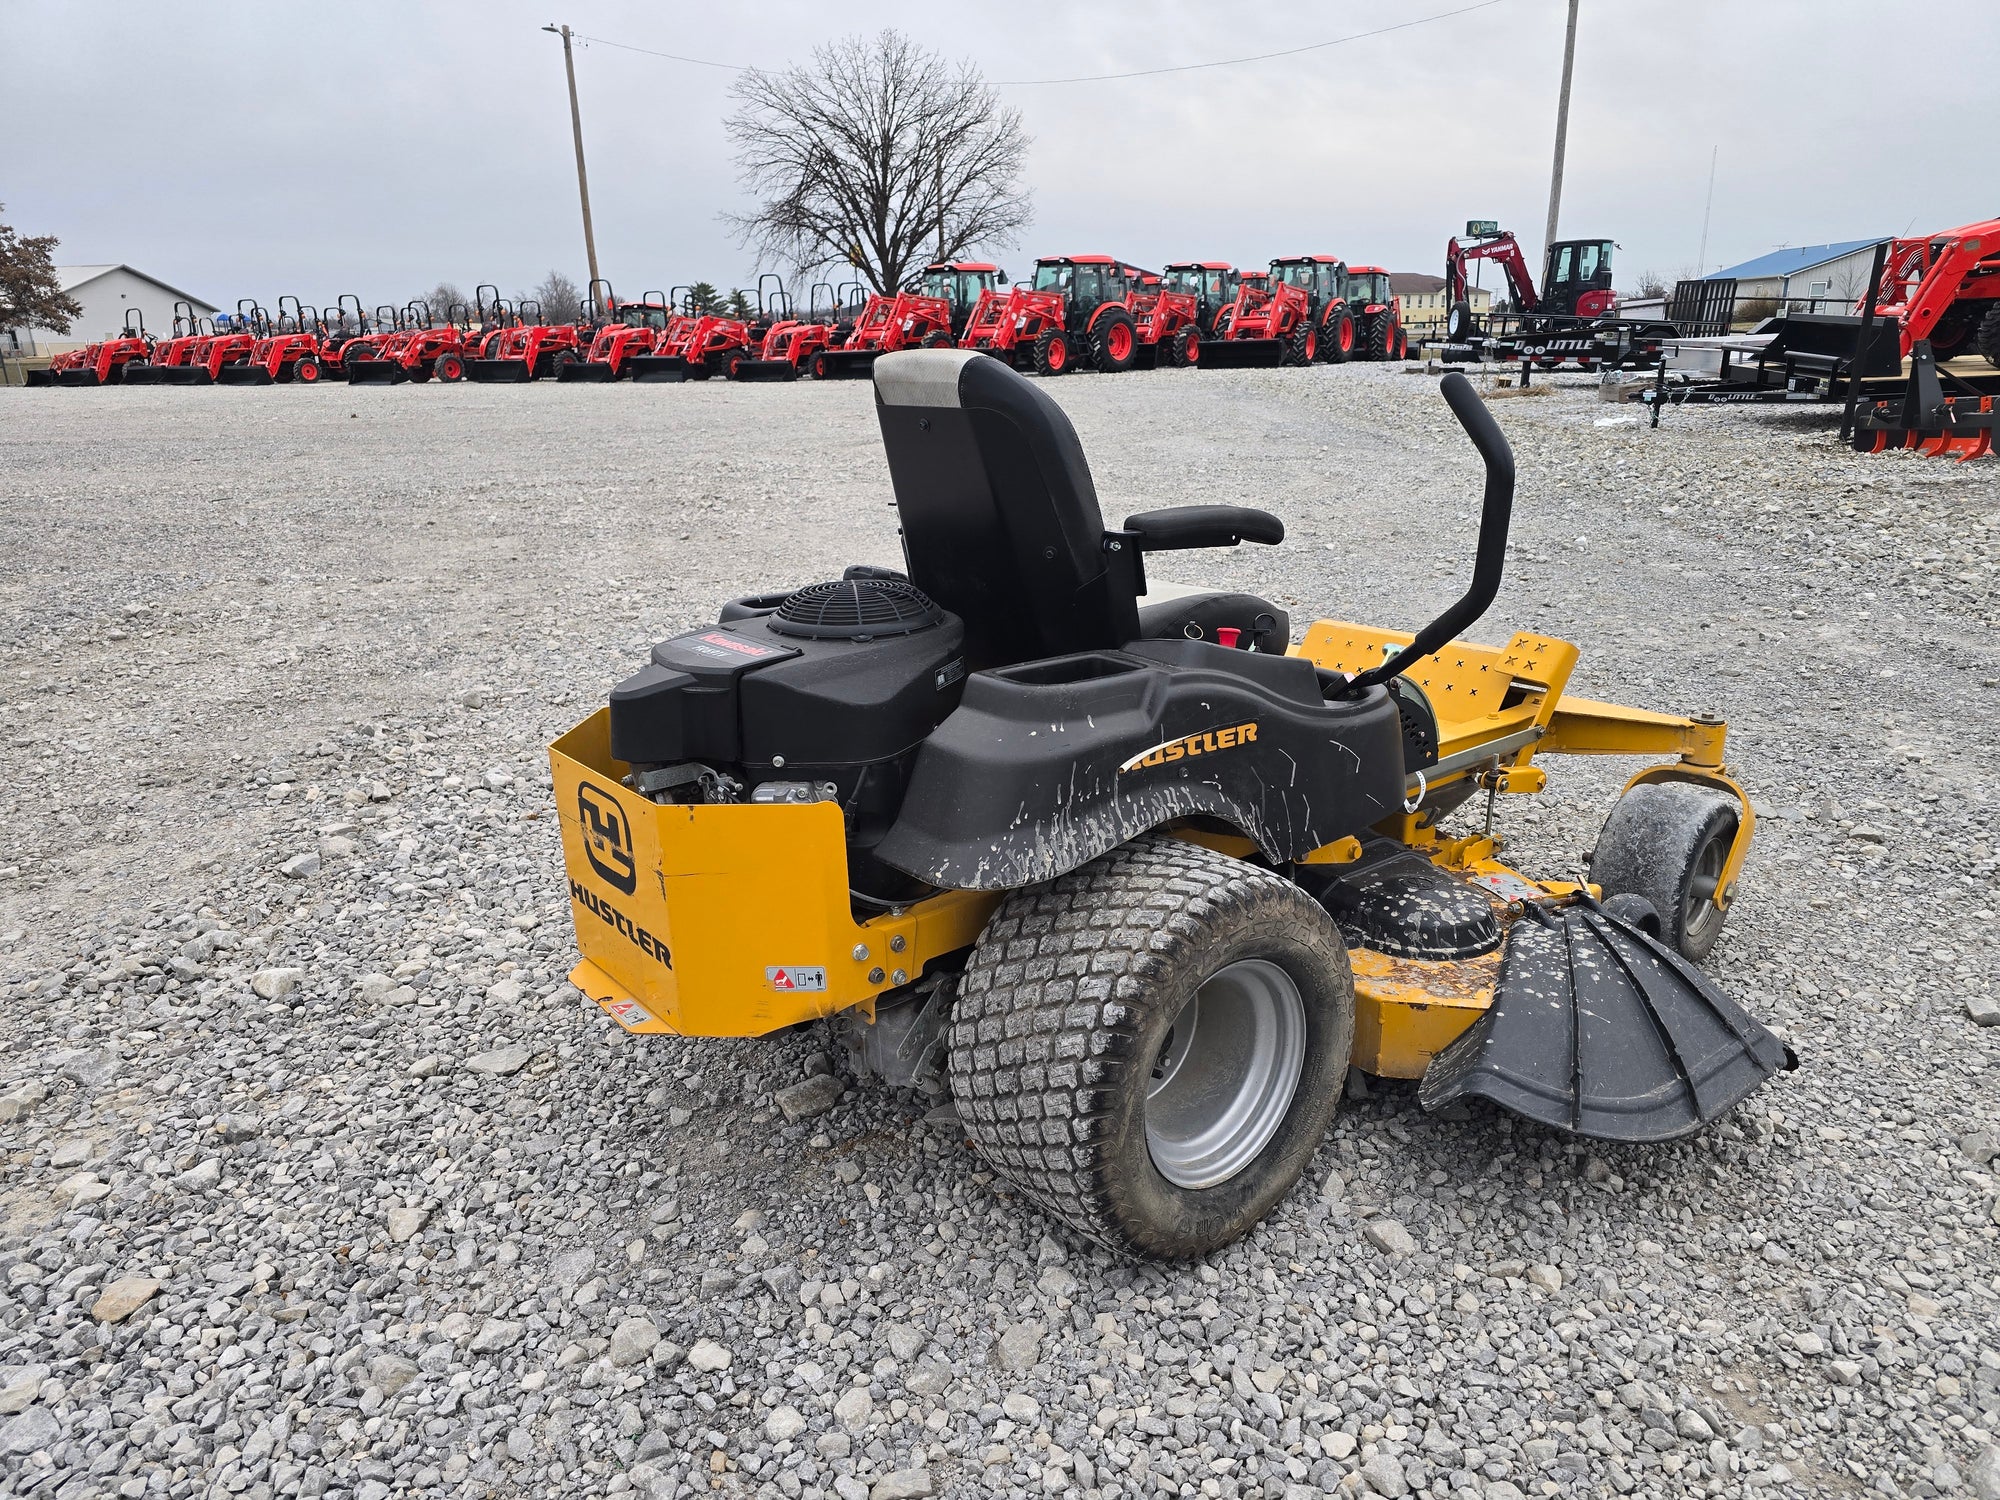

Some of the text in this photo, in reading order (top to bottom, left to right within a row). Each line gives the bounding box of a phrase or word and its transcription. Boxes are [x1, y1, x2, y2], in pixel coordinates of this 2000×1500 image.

[1490, 243, 1514, 254] YANMAR
[699, 633, 769, 657] Kawasaki
[1120, 722, 1259, 773] USTLER
[569, 878, 673, 971] HUSTLER
